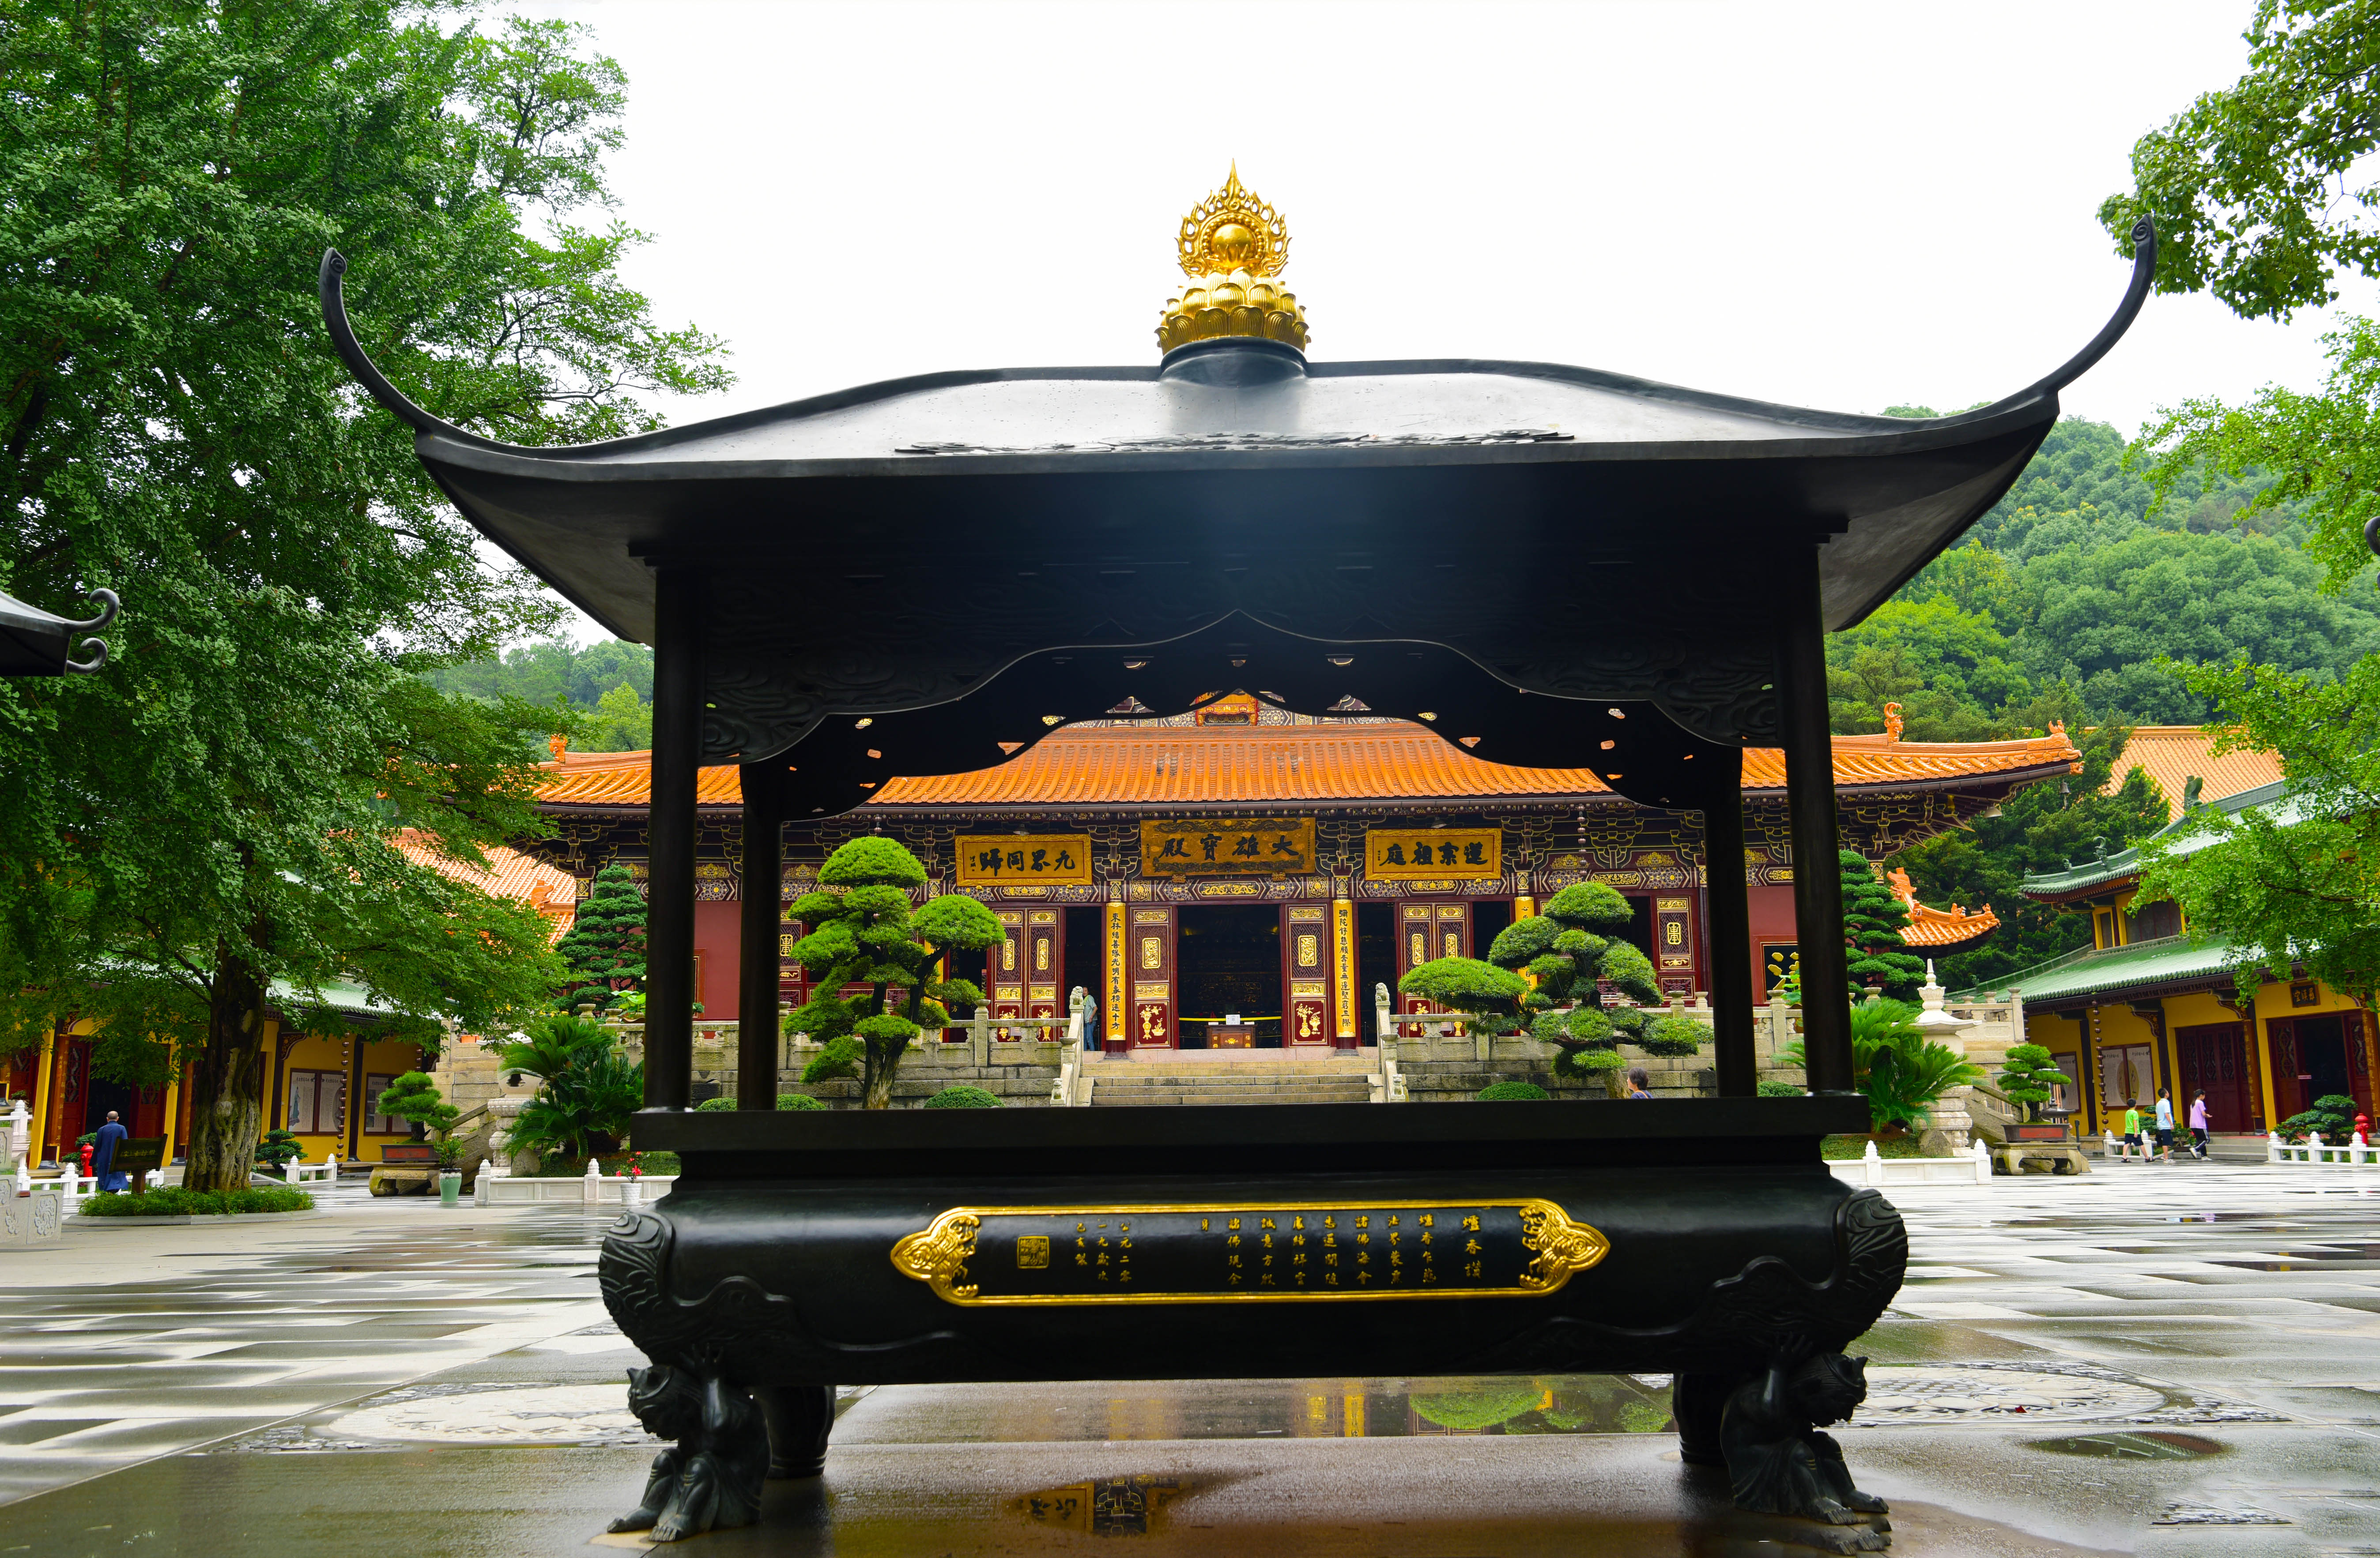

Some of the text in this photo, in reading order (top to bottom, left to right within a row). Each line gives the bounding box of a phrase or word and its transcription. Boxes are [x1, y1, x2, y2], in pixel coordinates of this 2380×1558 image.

[1158, 834, 1299, 861] 大雄寶殿
[1379, 842, 1488, 866] 蓮宗祖庭
[979, 848, 1075, 877] 九界同歸
